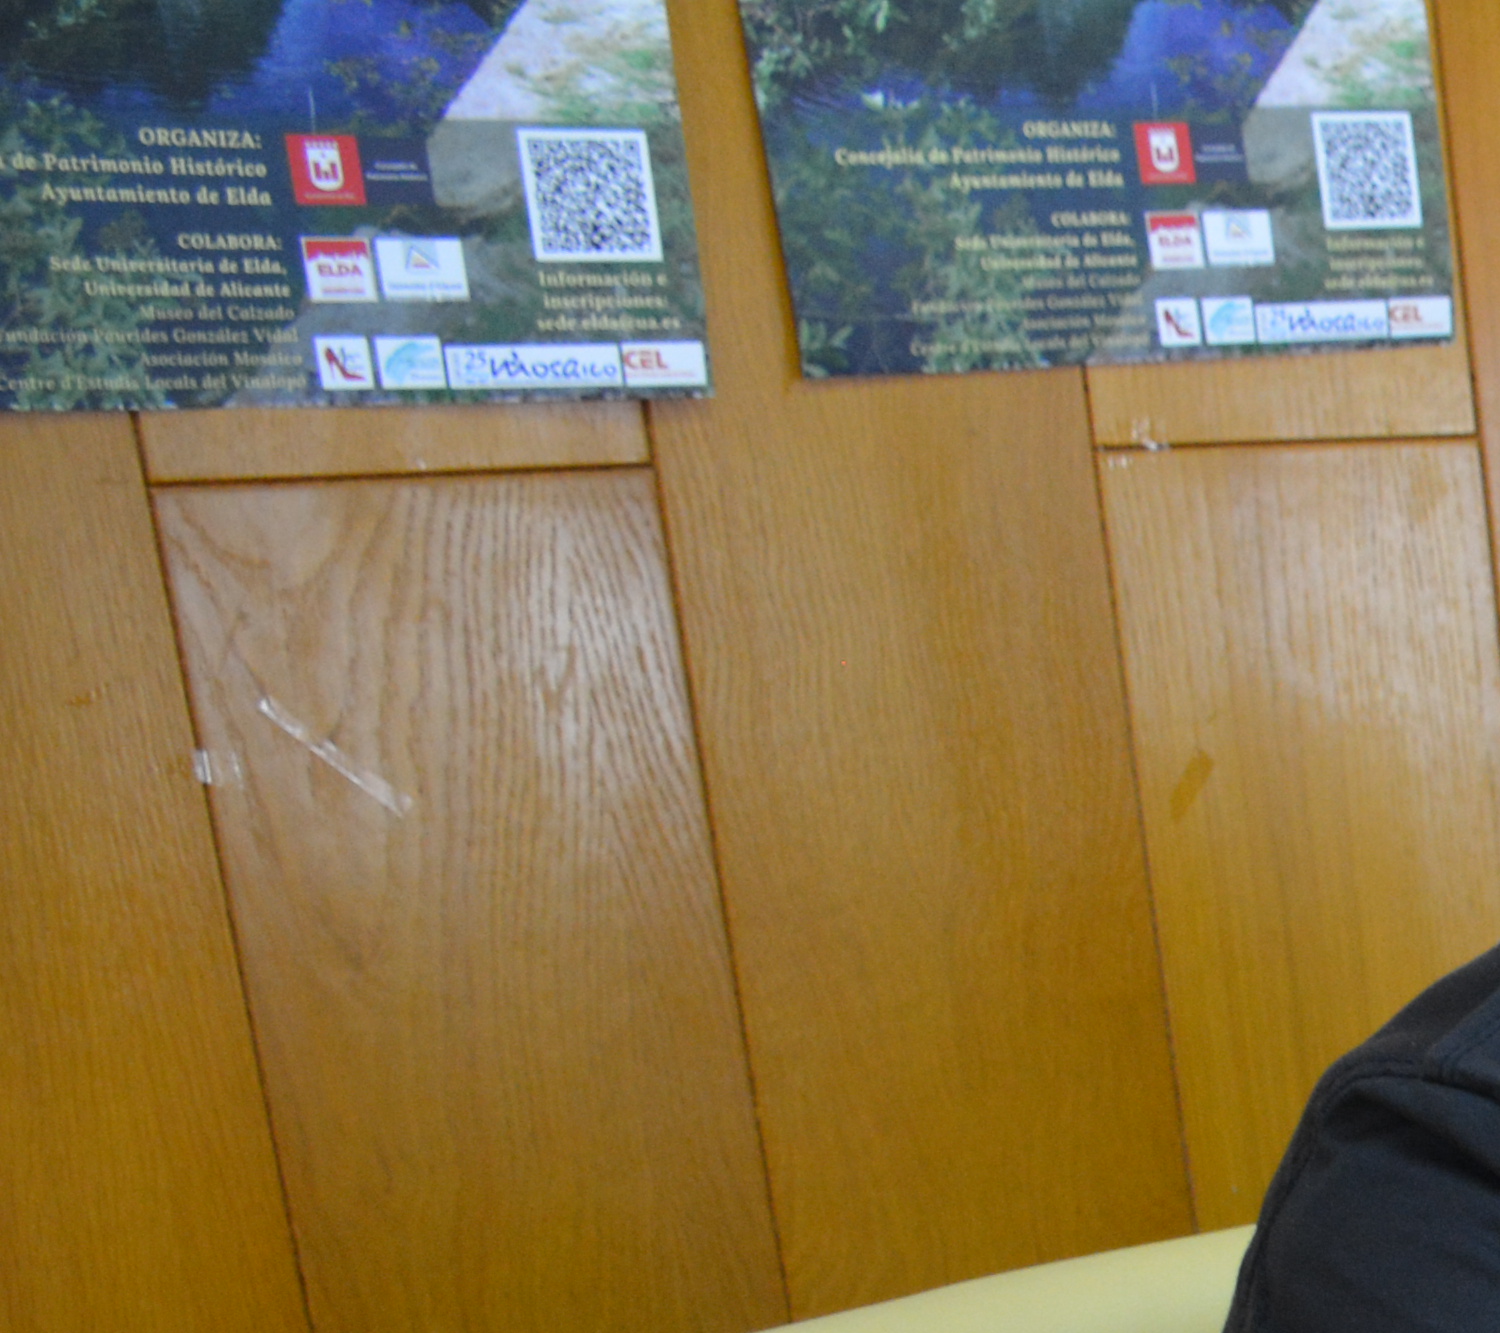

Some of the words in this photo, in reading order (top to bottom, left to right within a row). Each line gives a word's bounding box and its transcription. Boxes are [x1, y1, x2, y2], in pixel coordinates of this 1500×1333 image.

[139, 127, 262, 149] ORGANIZA:
[12, 152, 37, 171] de
[43, 153, 165, 175] Patrimonio
[170, 156, 268, 178] Histórico
[41, 183, 191, 206] Ayuntamiento
[197, 186, 220, 205] de
[226, 187, 272, 206] Elda
[177, 233, 282, 250] COLABORA:
[50, 255, 91, 272] Sede
[219, 258, 239, 274] de
[317, 263, 362, 277] ELDA
[84, 280, 190, 298] Universidad
[196, 282, 215, 298] de
[220, 282, 291, 298] Alicante
[623, 350, 668, 370] CEL
